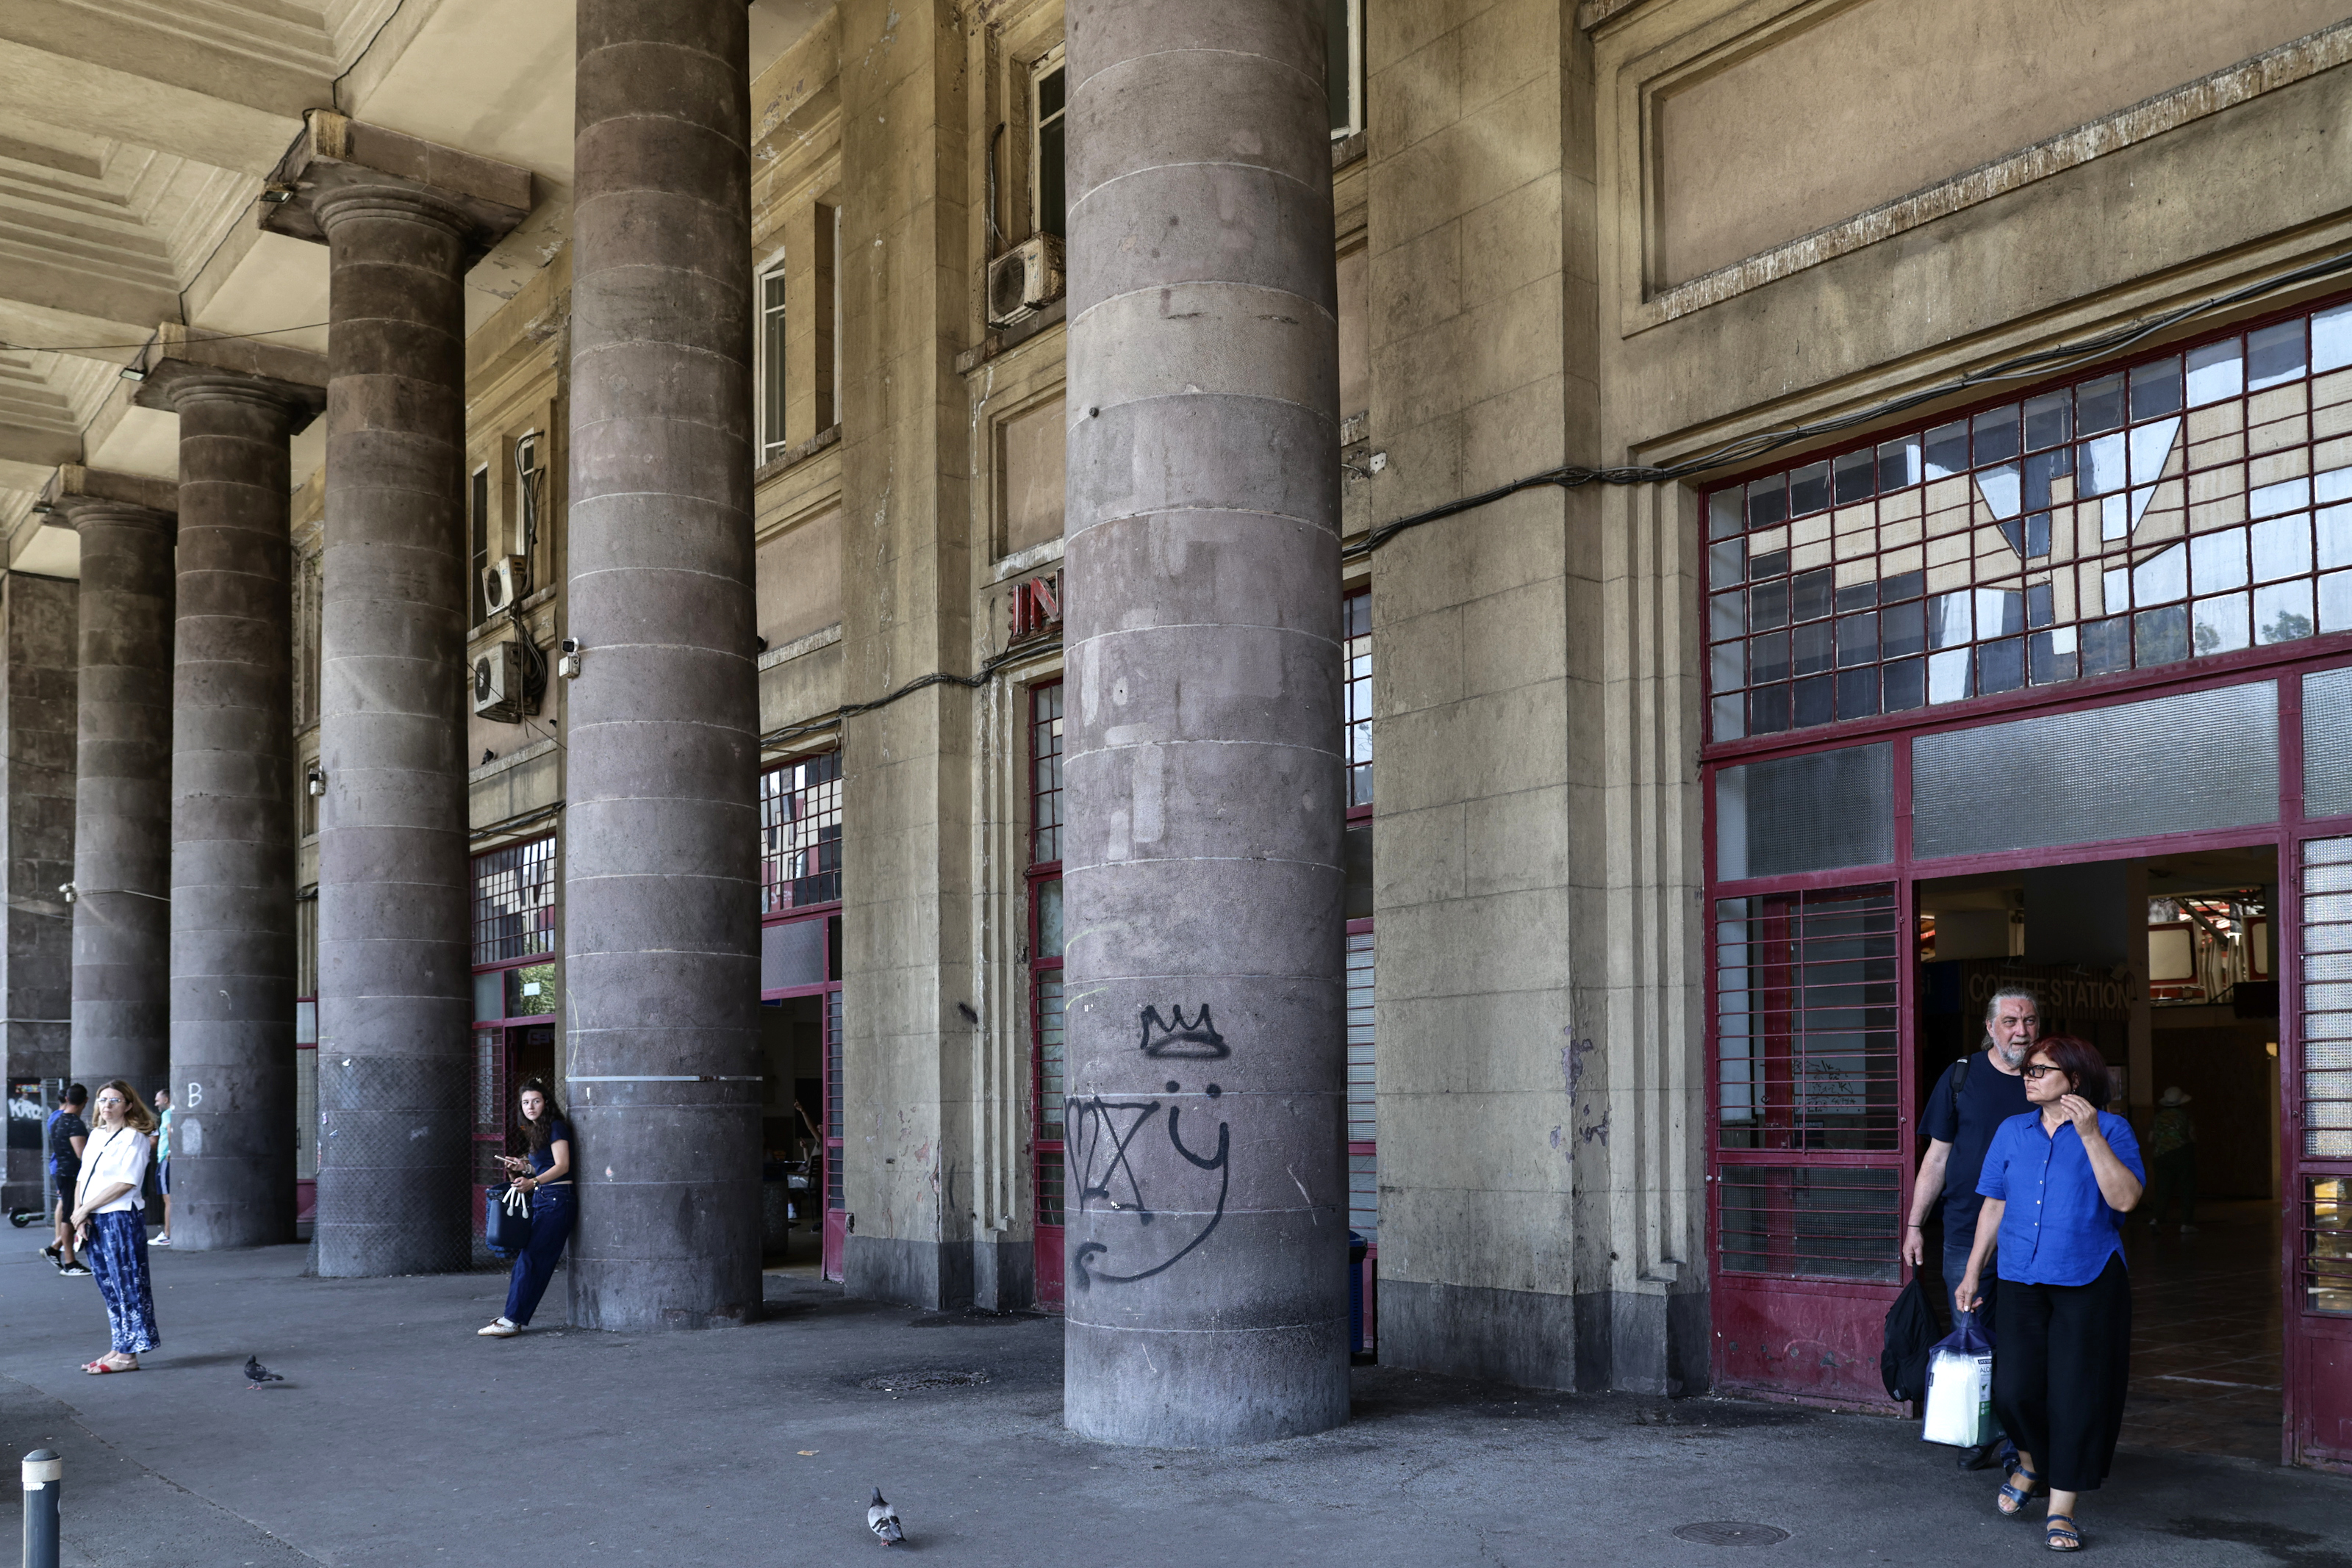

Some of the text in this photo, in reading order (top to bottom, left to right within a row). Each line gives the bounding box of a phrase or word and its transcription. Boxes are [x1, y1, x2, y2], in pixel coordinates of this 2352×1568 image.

[1969, 973, 2130, 1010] COE STATION
[187, 1082, 202, 1108] B
